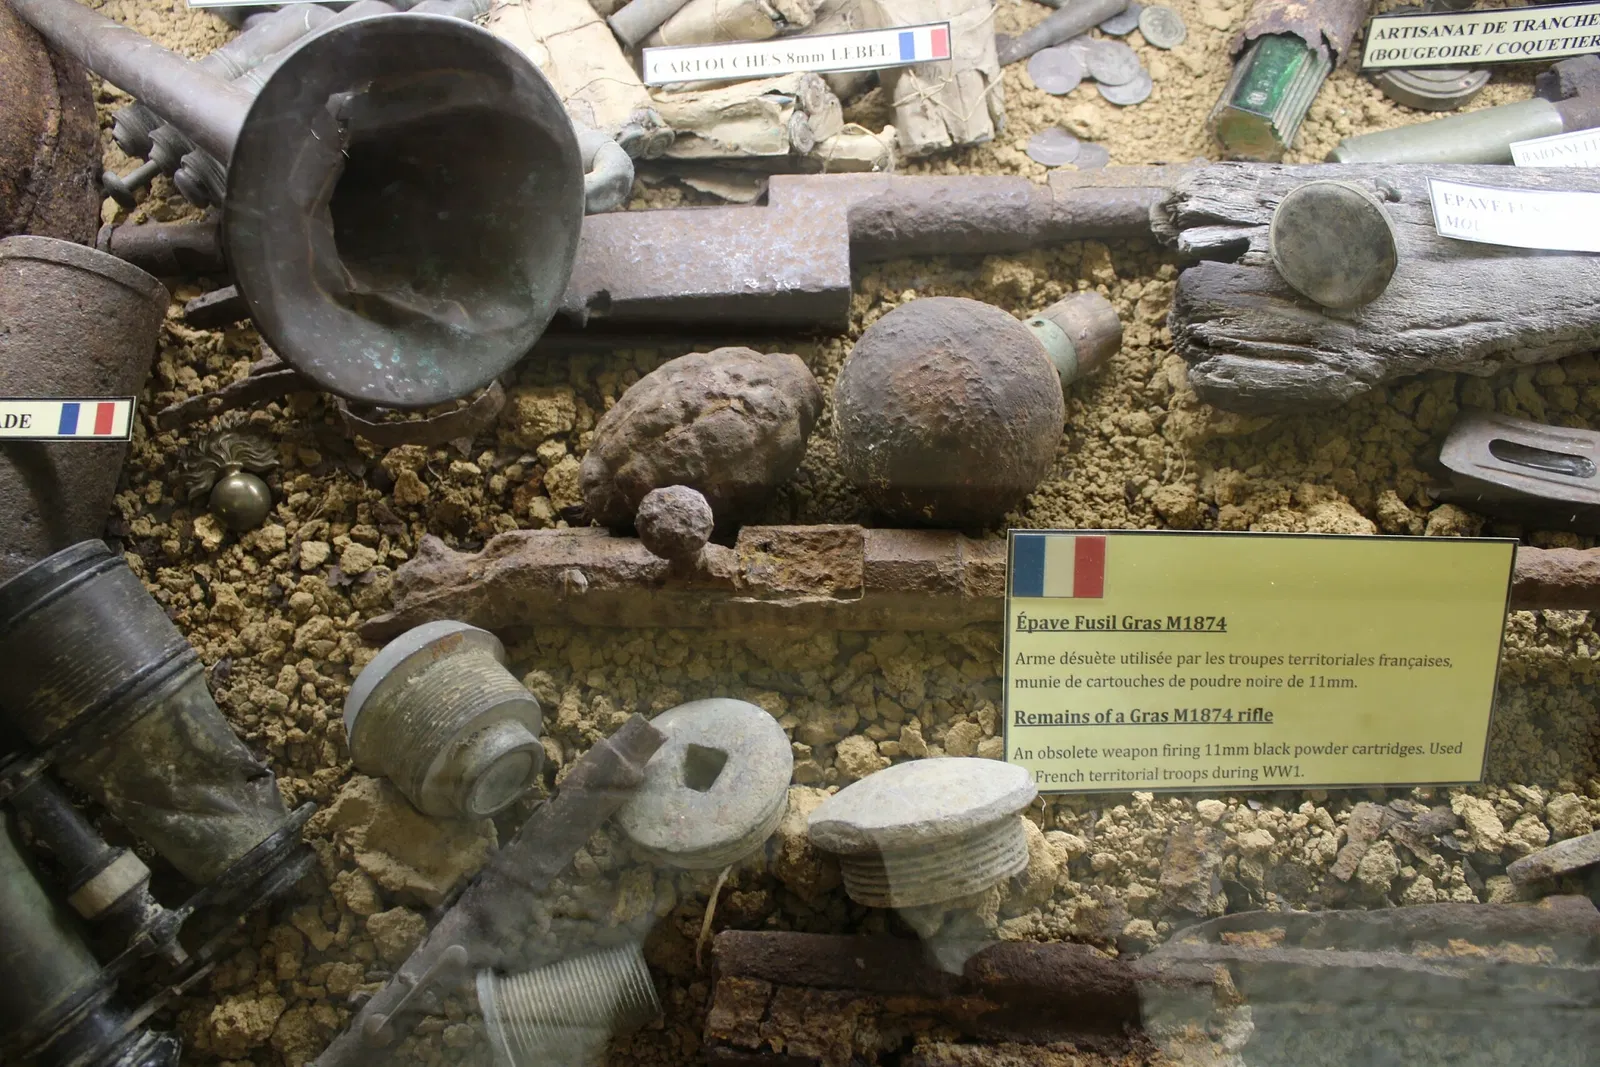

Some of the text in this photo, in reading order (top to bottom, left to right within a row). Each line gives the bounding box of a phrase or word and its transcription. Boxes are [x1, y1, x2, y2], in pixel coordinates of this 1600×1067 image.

[1374, 22, 1479, 40] ARTISANAT
[1482, 20, 1507, 35] DE
[653, 43, 893, 74] CARTOUCHES 8mm LEBEL
[1370, 44, 1482, 63] (BOUGEOIRE
[0, 413, 32, 429] DE
[1016, 611, 1227, 633] Épave Fusil Gras M1874
[1015, 651, 1453, 669] Arme désuète utilisée par les troupes territoriales françaises,
[1015, 674, 1358, 691] munie de cartouches de poudre noire de 11mm.
[1014, 707, 1274, 726] Remains of a Gras M1874 rifle
[1013, 741, 1463, 761] An obsolete weapon firing 11mm black powder cartridges. Used
[1035, 765, 1305, 783] French territorial troops during WW1.
